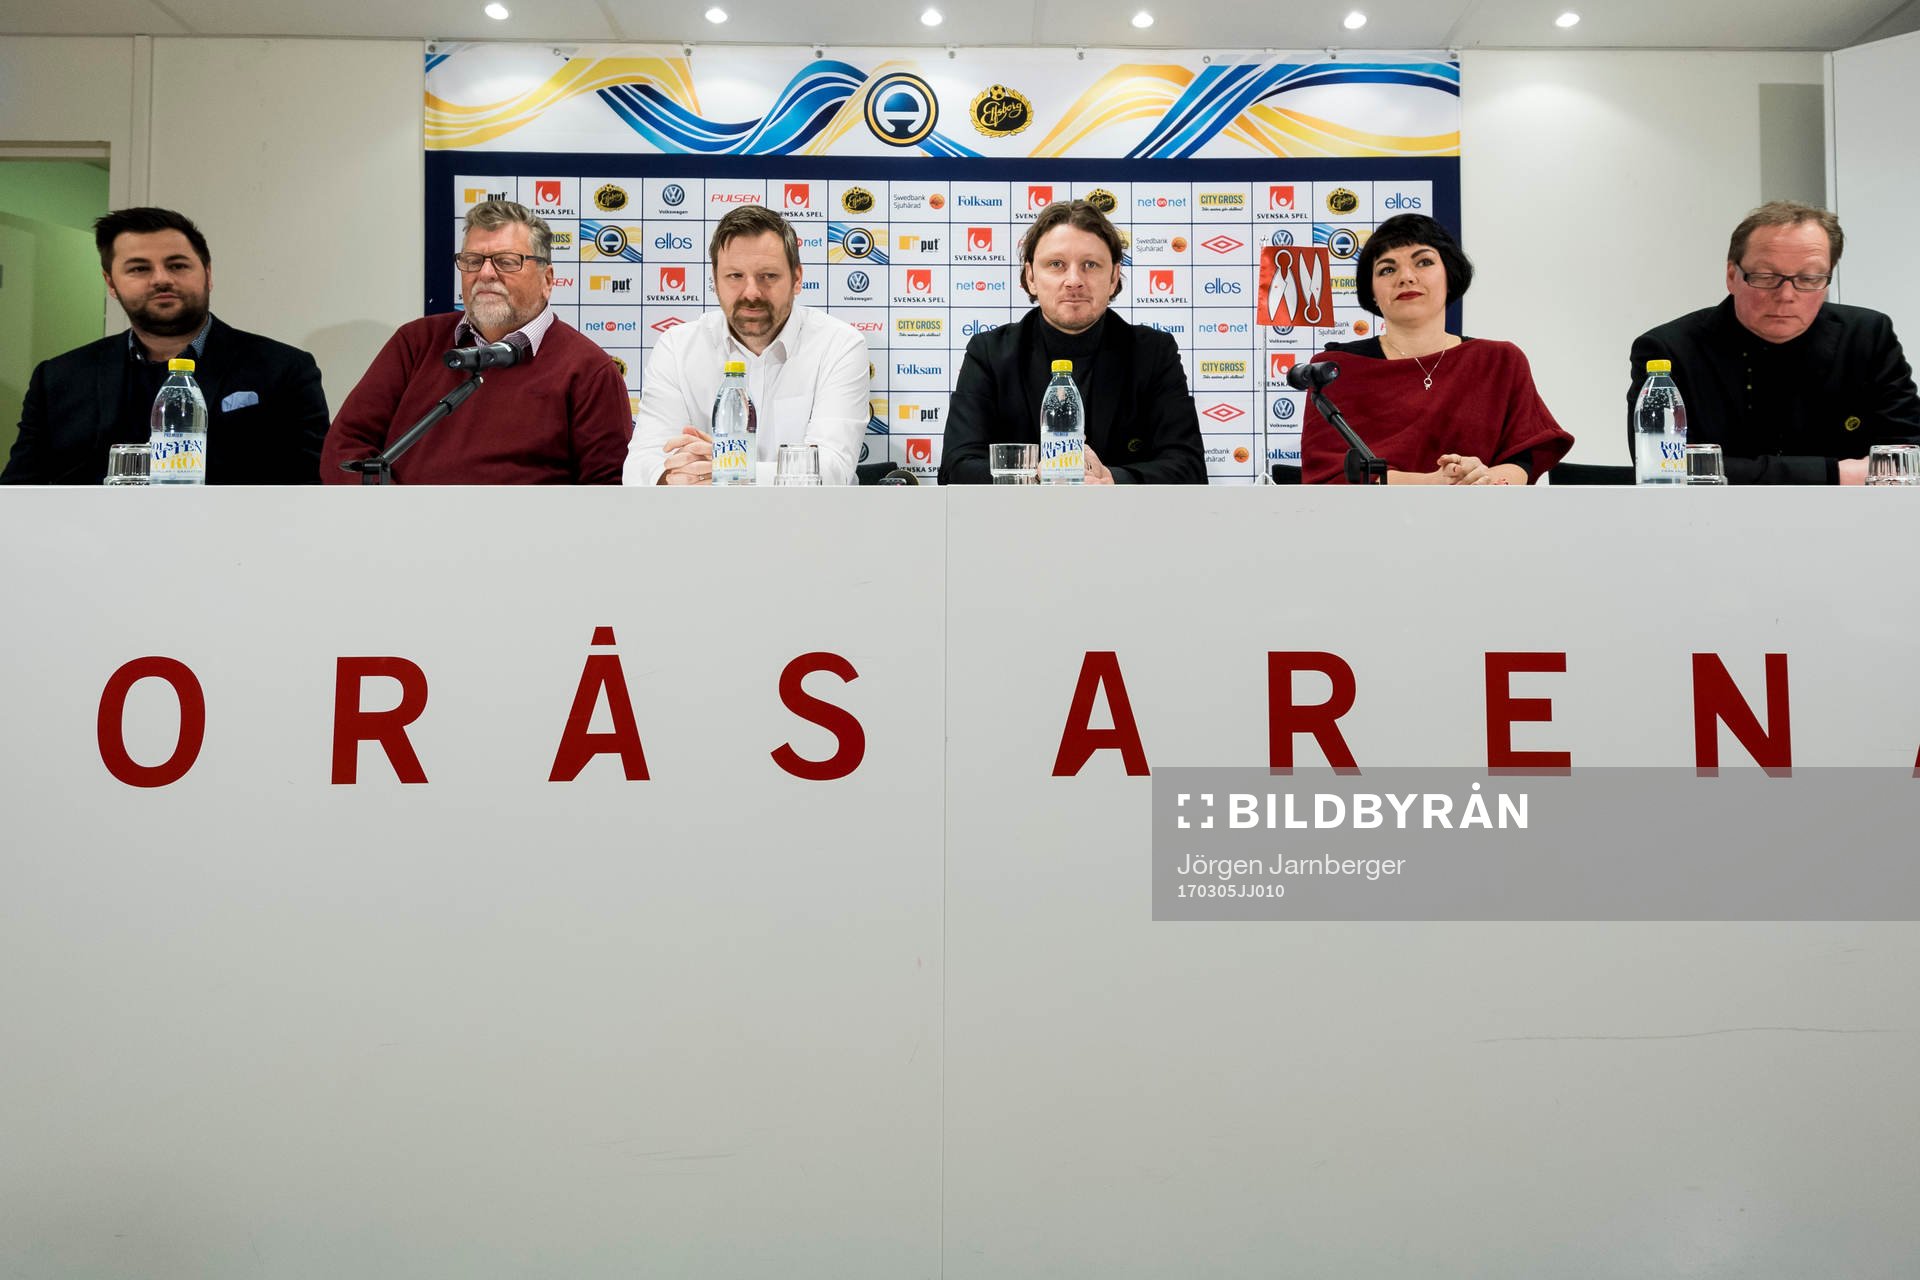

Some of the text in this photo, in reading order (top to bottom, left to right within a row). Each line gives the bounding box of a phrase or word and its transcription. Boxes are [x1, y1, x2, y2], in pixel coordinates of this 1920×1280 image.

[711, 194, 761, 203] PULSEN
[957, 196, 1003, 206] Folksam
[1201, 194, 1243, 204] CITY GROSS
[1385, 192, 1422, 209] ellos
[654, 232, 693, 250] ellos
[1136, 237, 1168, 245] Swedbank
[1204, 278, 1242, 294] ellos
[898, 320, 941, 330] CITY GROSS
[896, 363, 942, 374] Folksam
[1202, 362, 1245, 372] CITY GROSS
[1053, 652, 1920, 777] AREN
